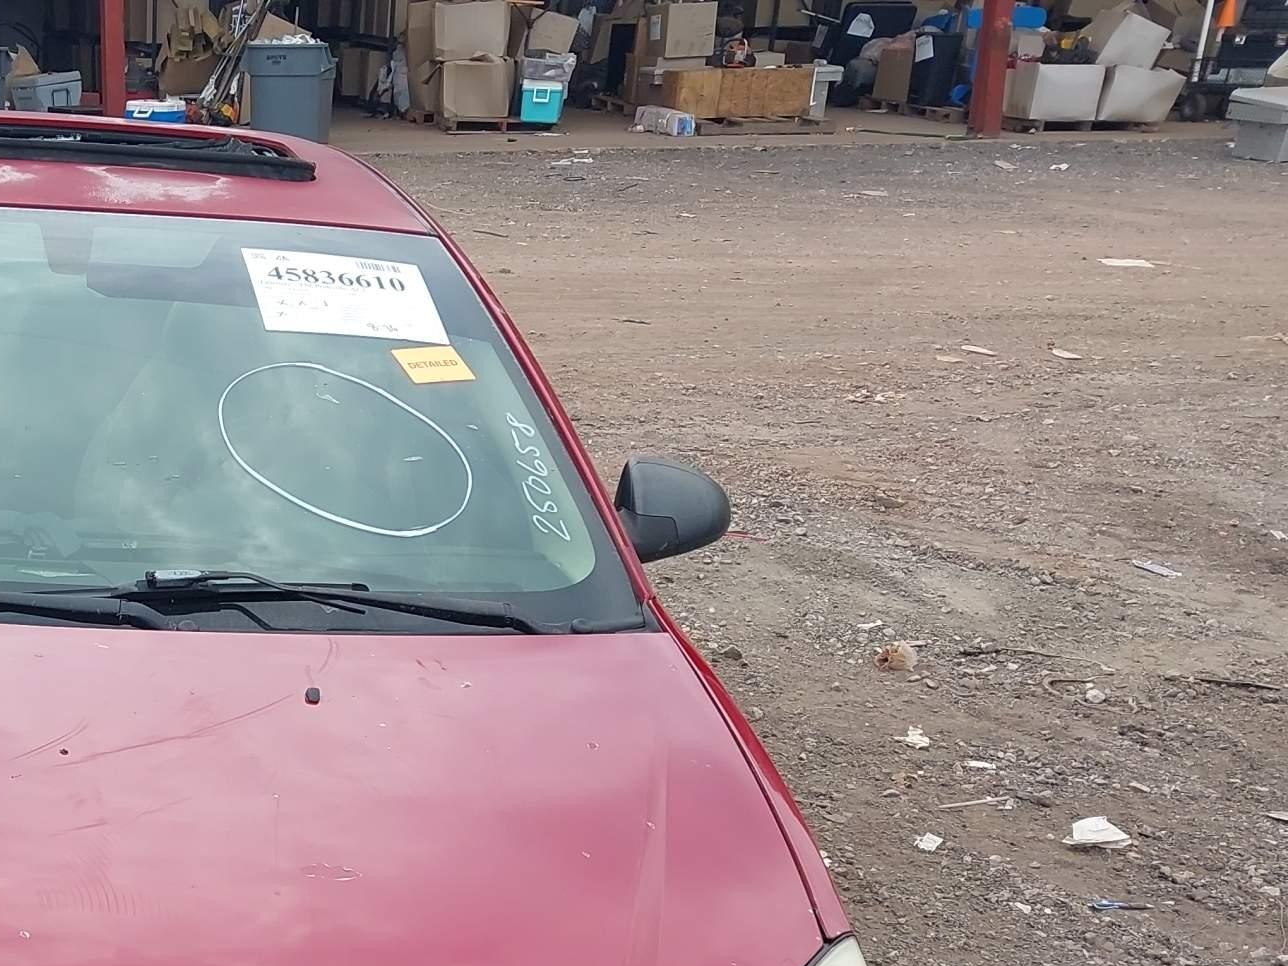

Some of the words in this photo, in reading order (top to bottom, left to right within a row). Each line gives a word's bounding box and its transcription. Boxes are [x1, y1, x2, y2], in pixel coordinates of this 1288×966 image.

[267, 266, 406, 292] 45836610
[408, 359, 458, 369] DETAILED
[506, 412, 571, 541] 280658
